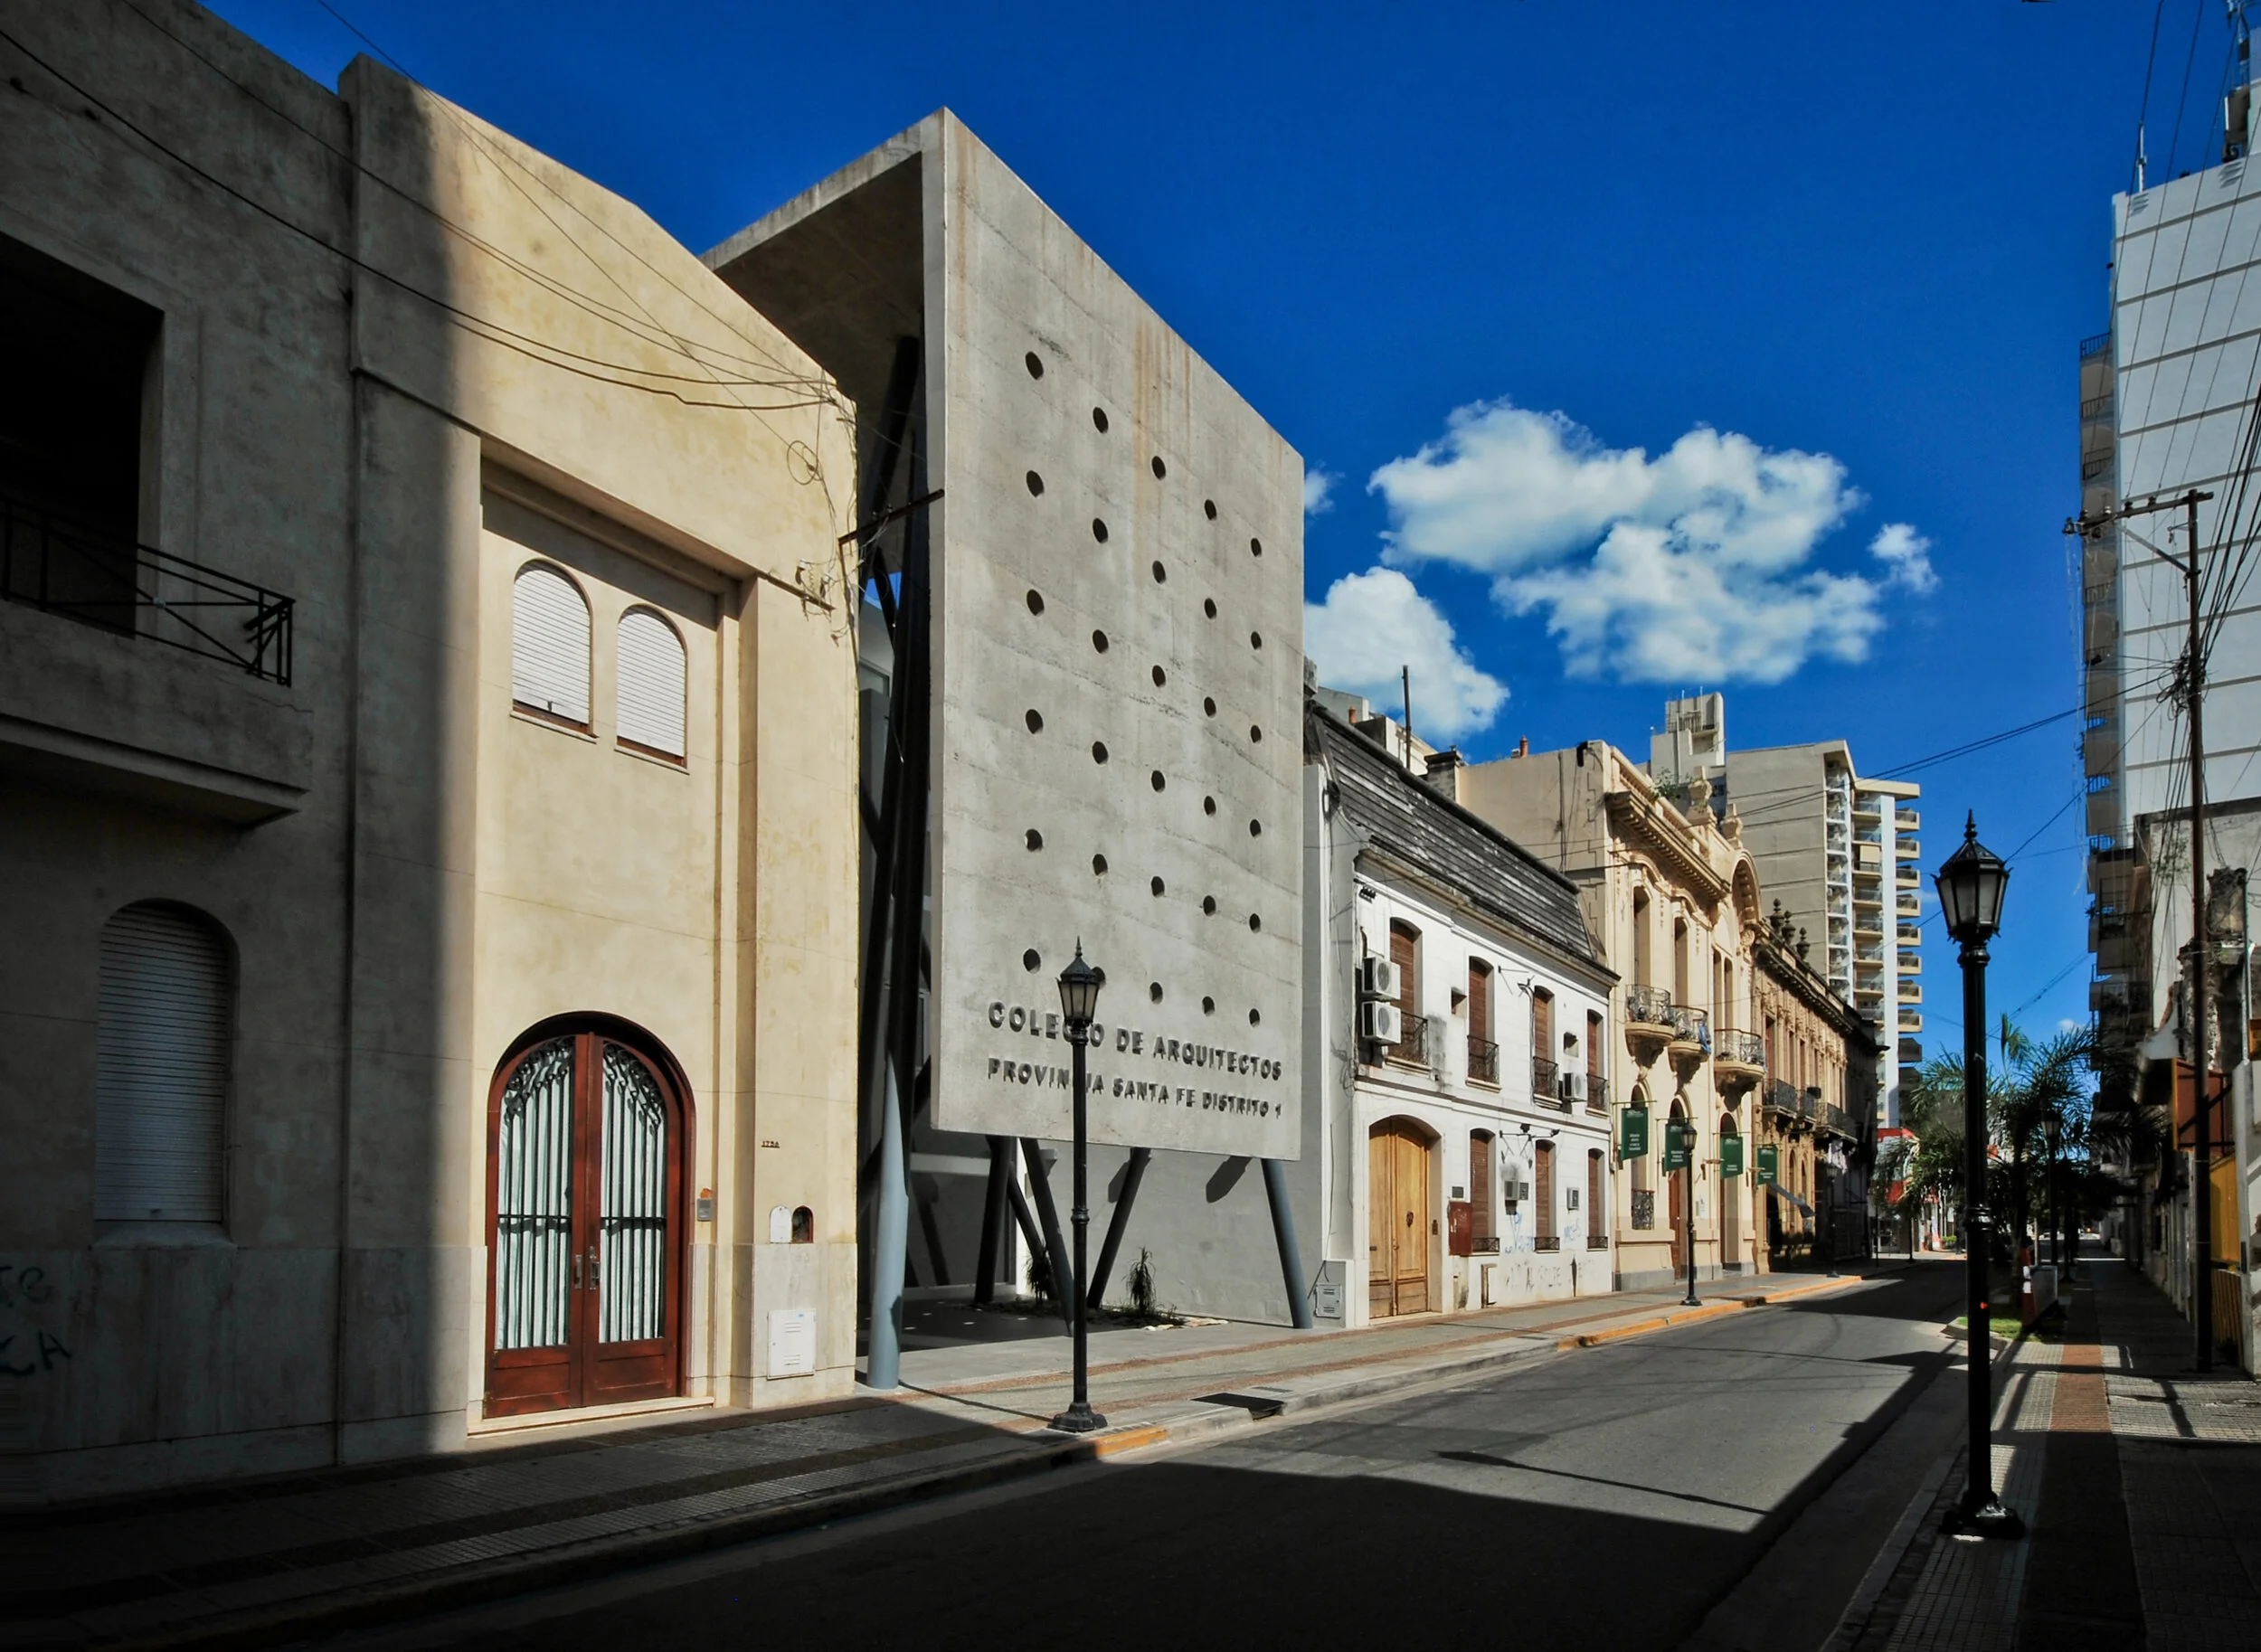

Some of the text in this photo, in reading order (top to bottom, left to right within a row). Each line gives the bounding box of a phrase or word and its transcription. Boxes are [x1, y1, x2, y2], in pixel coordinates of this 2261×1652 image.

[988, 1001, 1282, 1081] COLEO DE ARQUITECTOS
[988, 1057, 1282, 1120] PROVINIA SANTA FE DISTRITO 1
